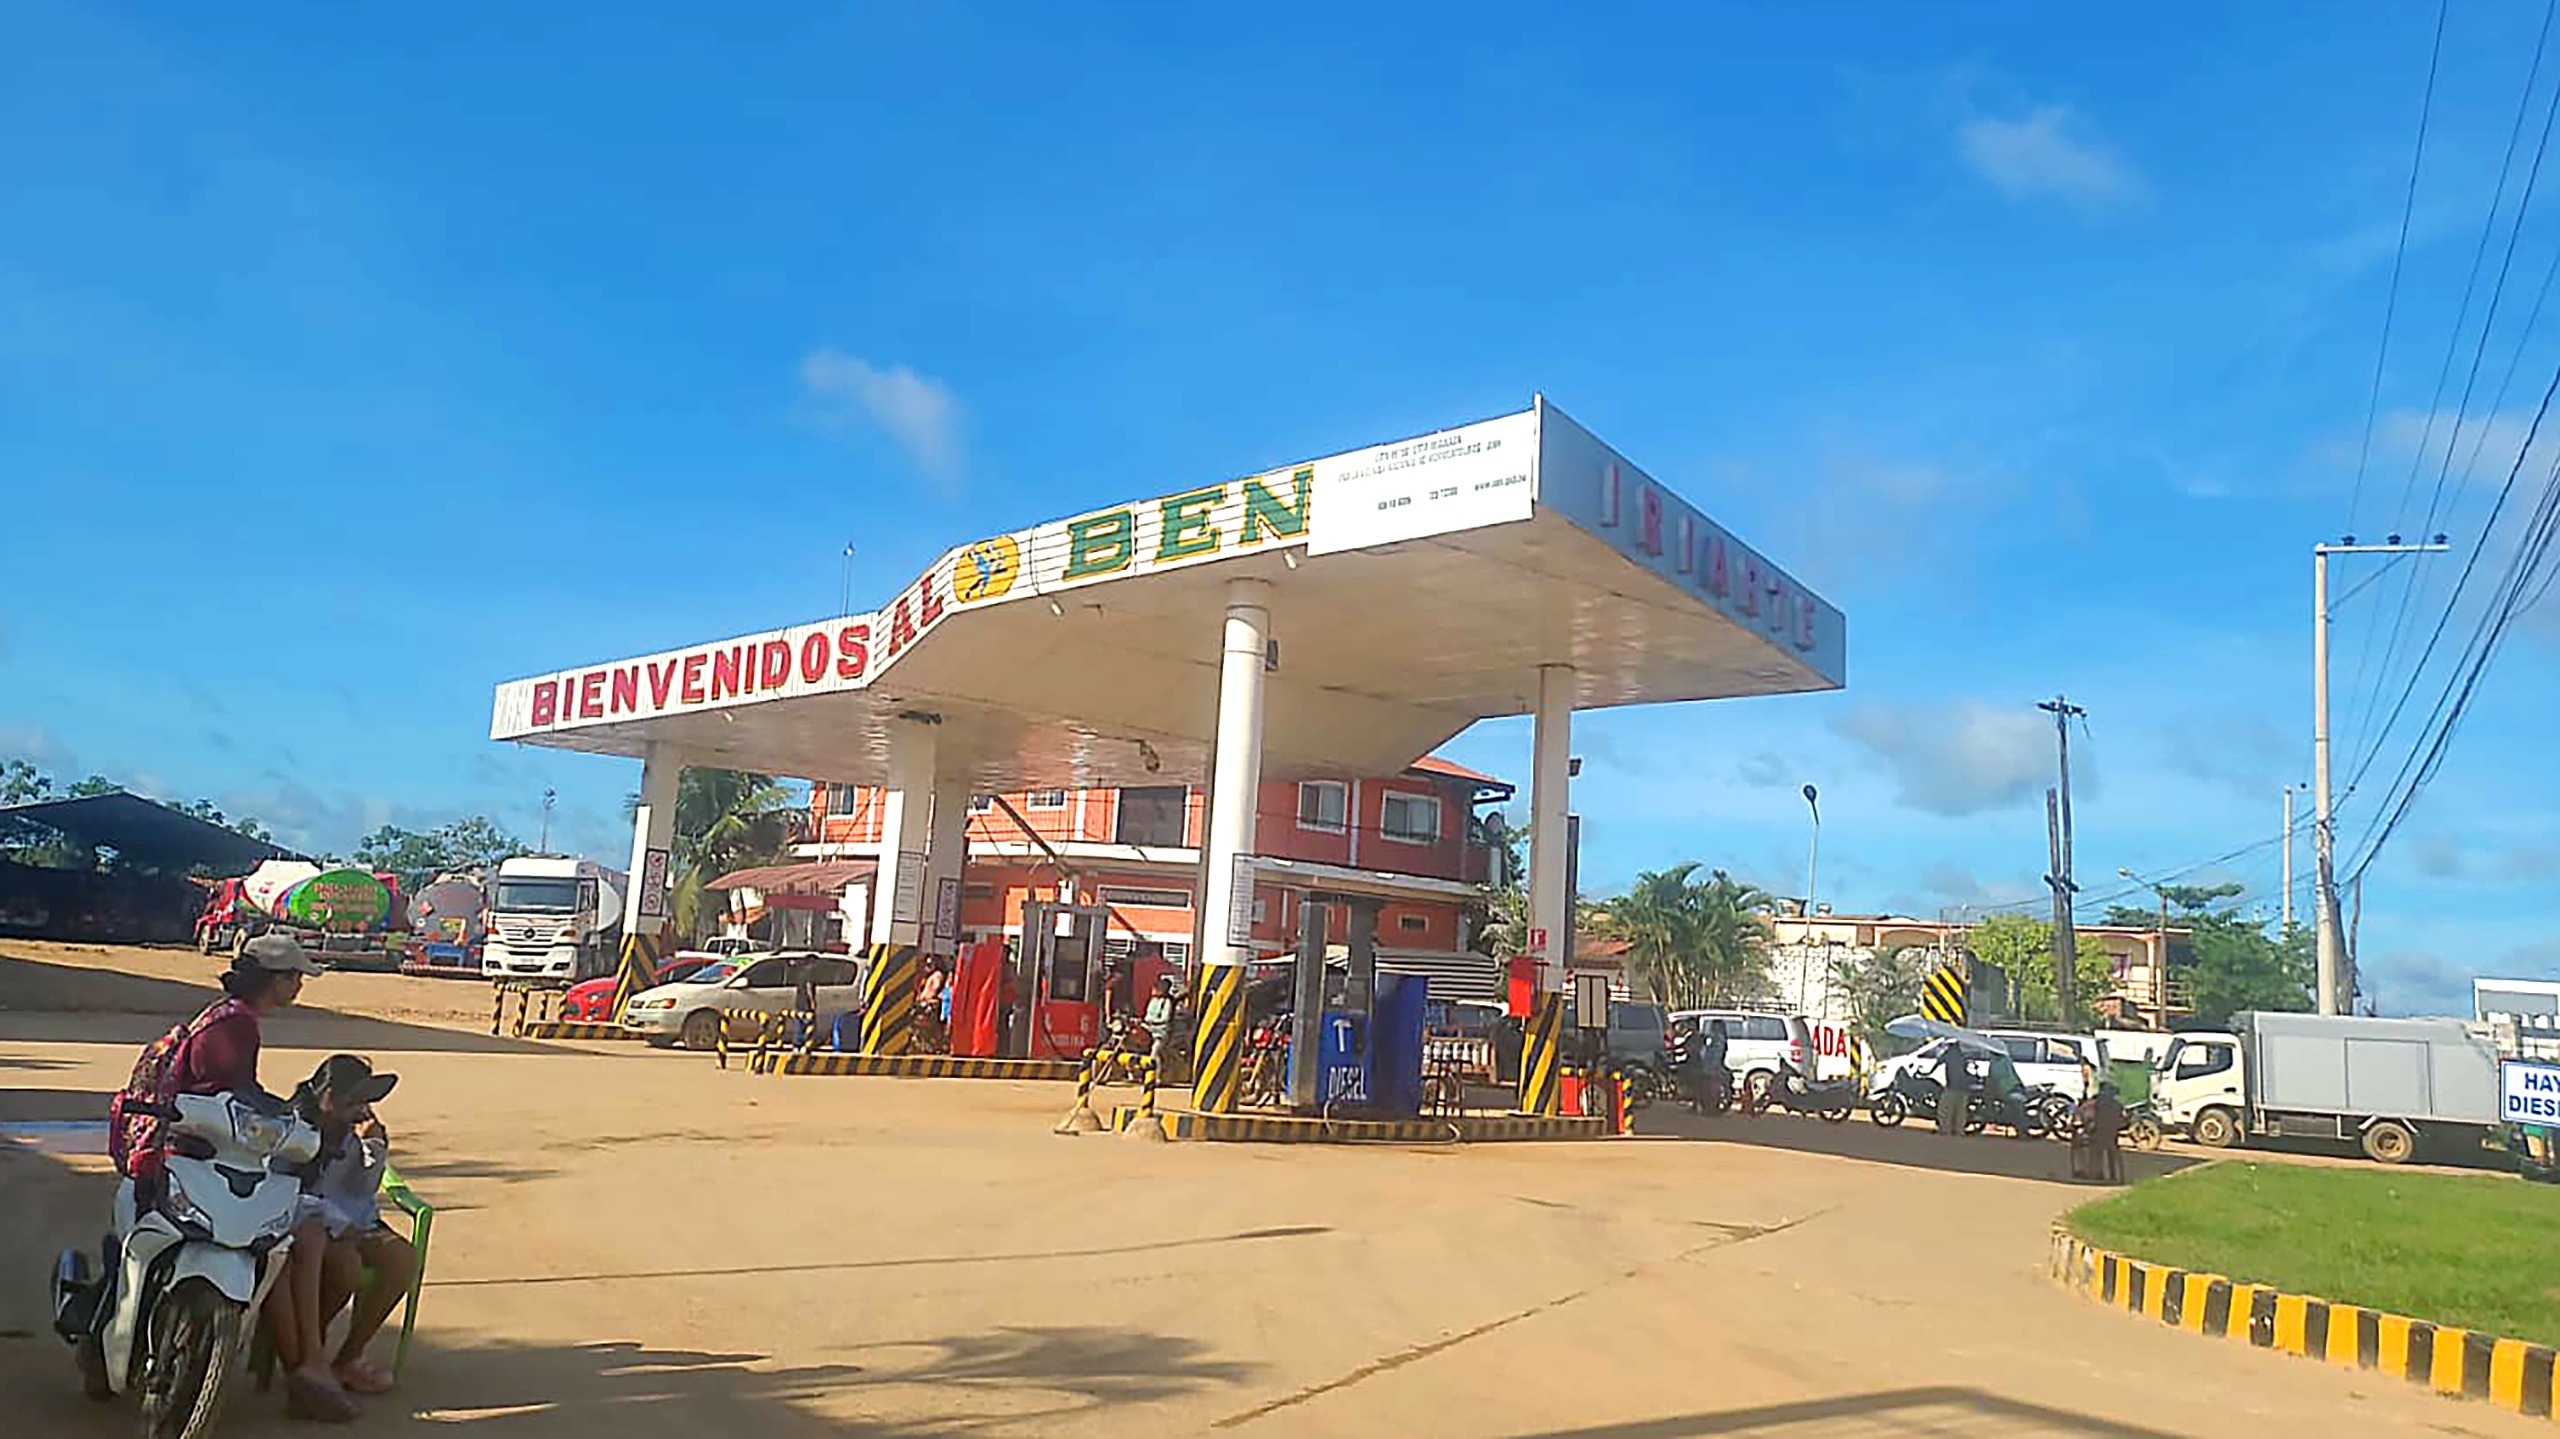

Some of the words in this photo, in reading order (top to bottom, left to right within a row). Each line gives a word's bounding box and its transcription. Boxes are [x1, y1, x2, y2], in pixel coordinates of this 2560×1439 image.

[531, 623, 871, 727] BIENVENIDOS
[888, 573, 944, 657] AL
[1062, 464, 1314, 583] BEN
[1600, 462, 1815, 652] IRIARTE
[2508, 1094, 2560, 1118] DIES
